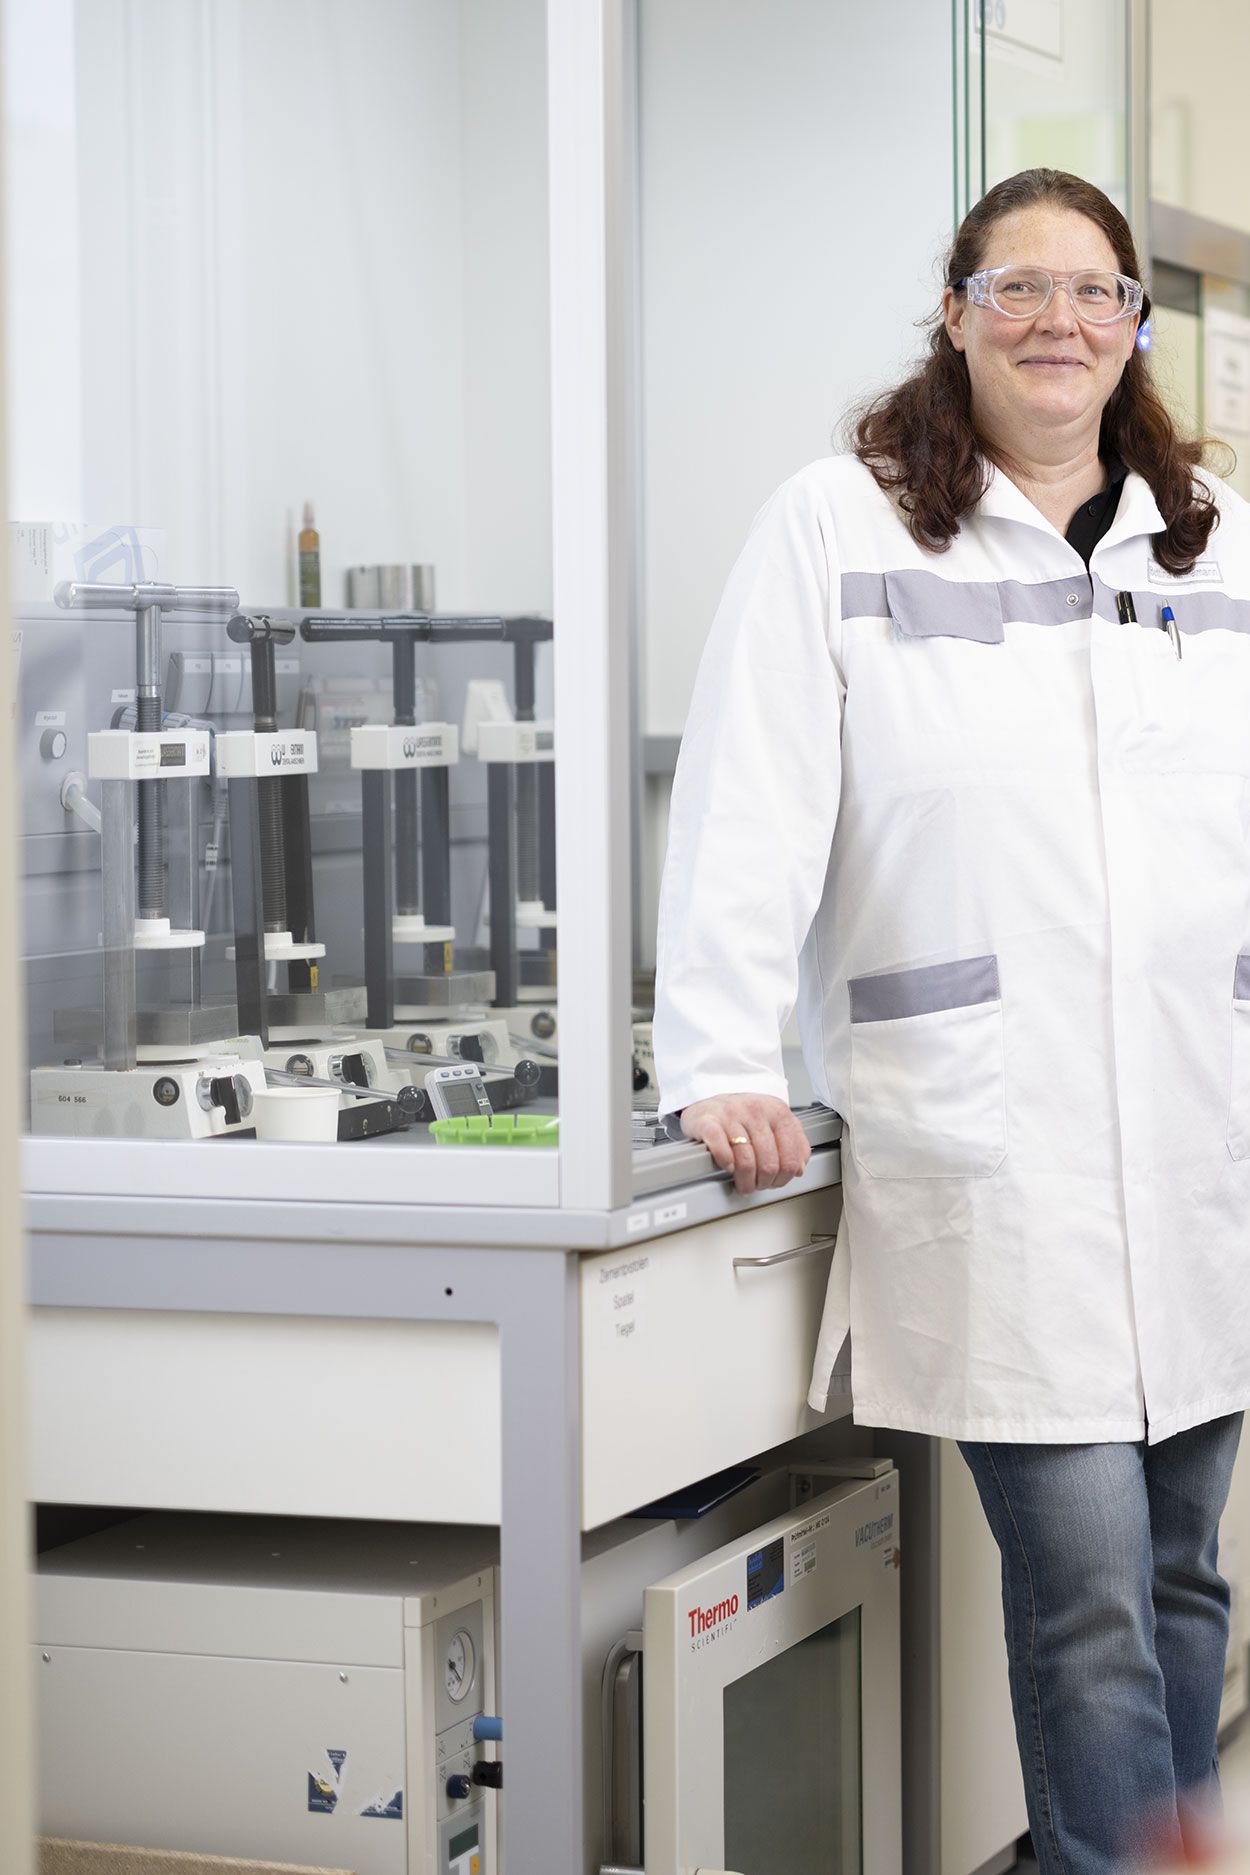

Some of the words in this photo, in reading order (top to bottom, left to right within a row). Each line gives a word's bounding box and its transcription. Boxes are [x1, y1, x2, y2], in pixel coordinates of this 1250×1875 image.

[615, 1318, 635, 1337] Tiegel
[688, 1594, 739, 1638] Thermo
[691, 1618, 738, 1653] SCIENTIFI
